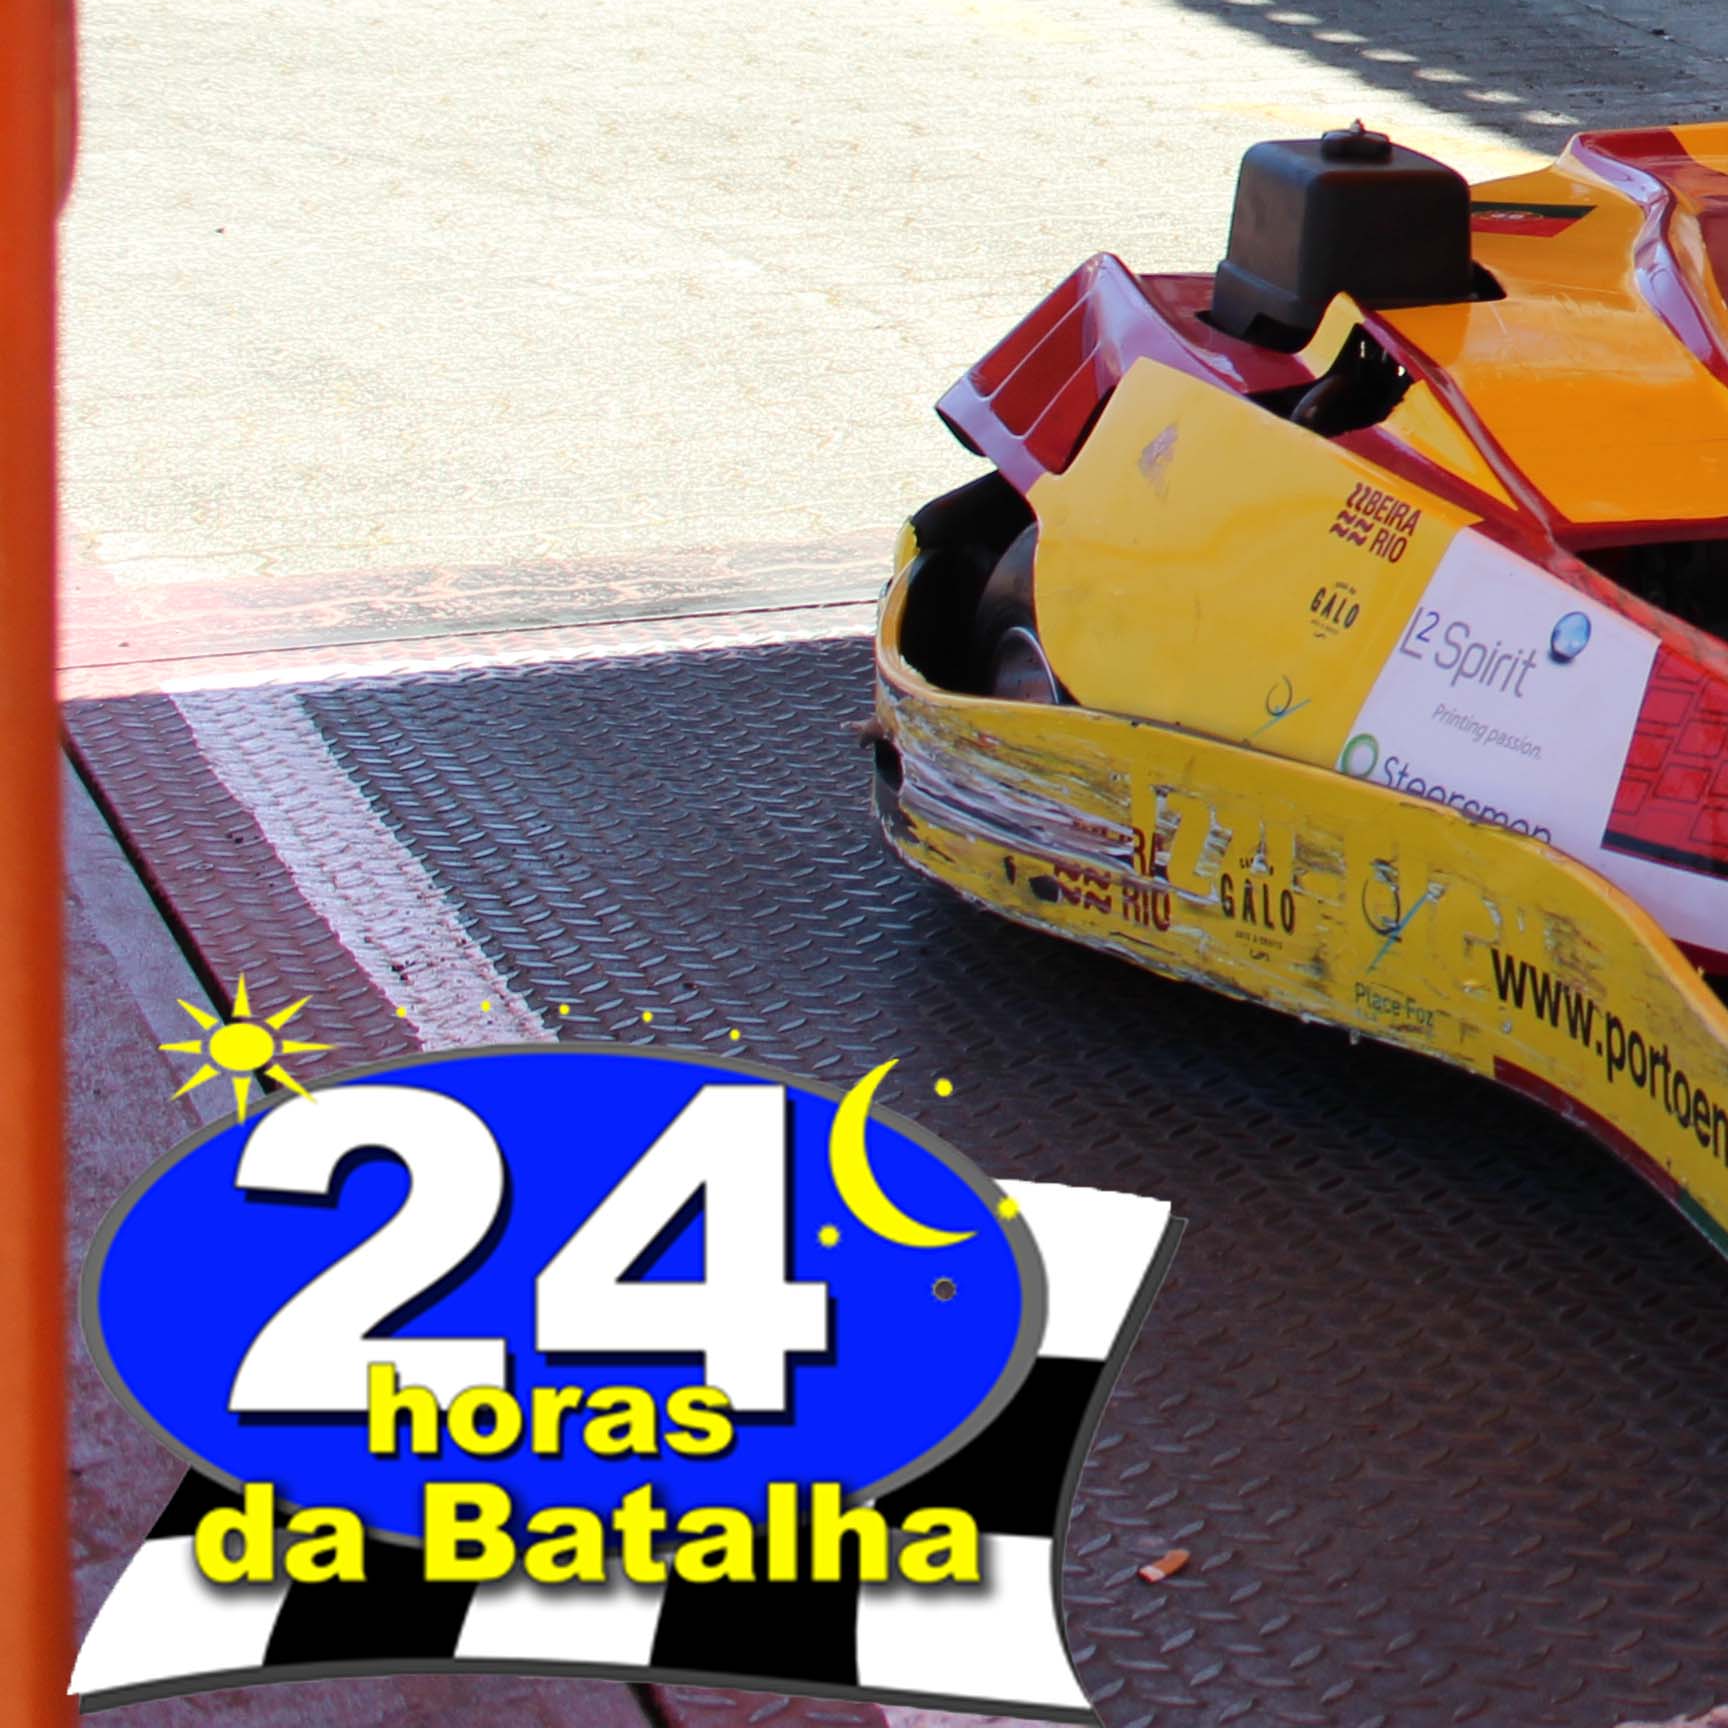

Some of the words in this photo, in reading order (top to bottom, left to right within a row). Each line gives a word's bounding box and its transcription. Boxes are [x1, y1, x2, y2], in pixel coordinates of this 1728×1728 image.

[1369, 528, 1408, 564] RIO
[1310, 586, 1361, 629] GALO
[1433, 620, 1538, 699] Spirit
[1431, 703, 1489, 744] Printing
[1220, 872, 1296, 936] GALO
